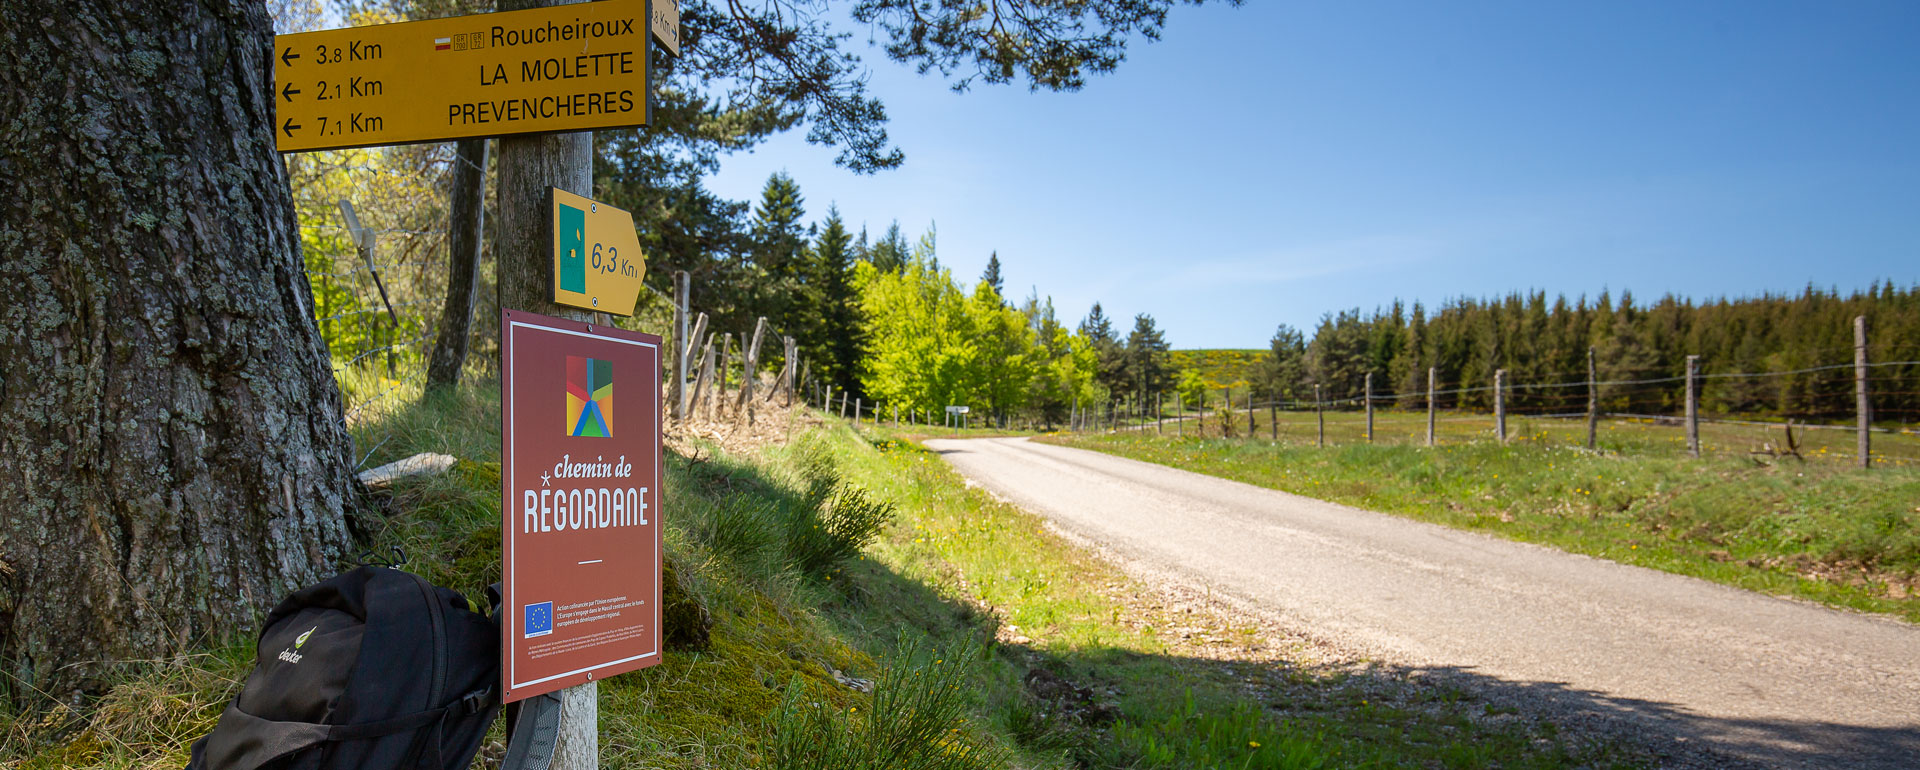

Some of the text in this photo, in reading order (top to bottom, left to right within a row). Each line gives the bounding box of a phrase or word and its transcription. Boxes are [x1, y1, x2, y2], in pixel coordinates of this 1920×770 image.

[456, 34, 465, 43] GR
[473, 33, 482, 41] GR
[491, 18, 635, 48] Roucheiroux
[316, 40, 382, 65] 3.8 Km
[455, 42, 466, 50] 700
[480, 51, 633, 86] LA MOLETTE
[317, 77, 382, 100] 2.1 Km
[449, 90, 634, 126] PREVENCHERES
[317, 112, 383, 137] 7.1 Km
[591, 242, 618, 275] 6,3
[554, 453, 632, 479] chemin de
[279, 648, 302, 664] deuter
